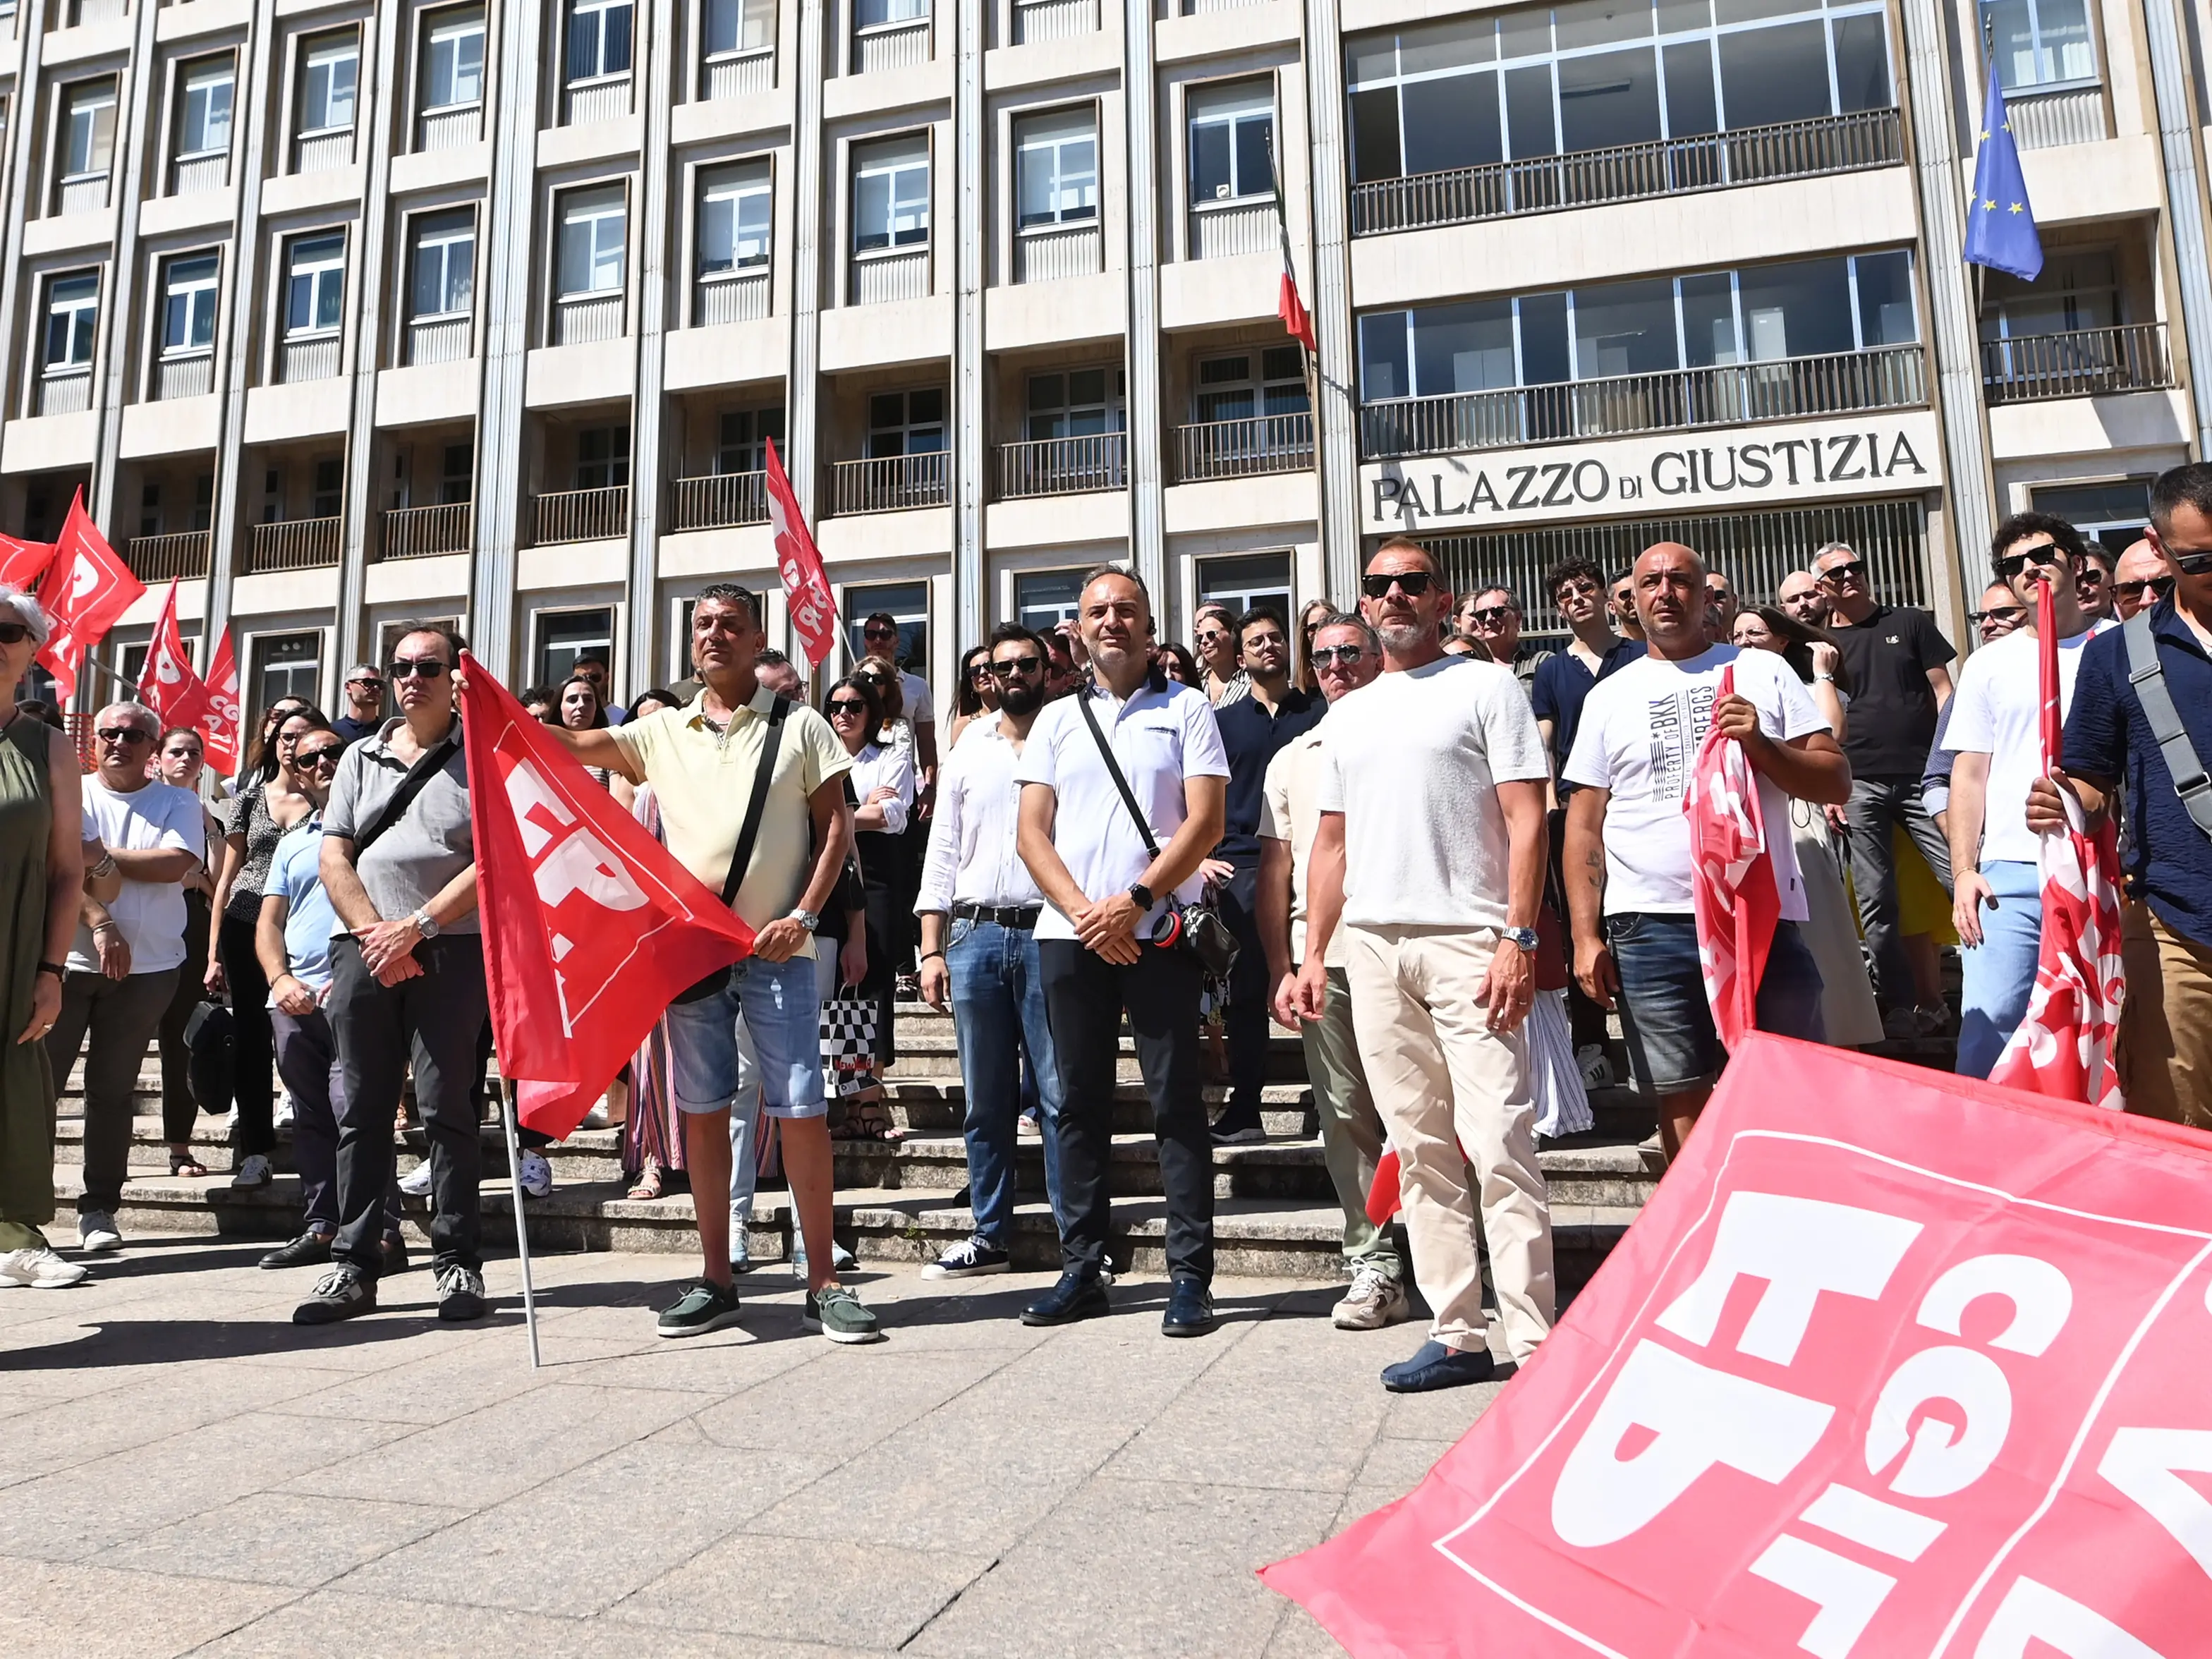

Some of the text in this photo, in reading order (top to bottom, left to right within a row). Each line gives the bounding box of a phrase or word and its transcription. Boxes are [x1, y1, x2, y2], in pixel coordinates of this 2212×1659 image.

[1371, 431, 1927, 521] PALAZZO DI GIUSTIZIA
[1664, 729, 1679, 741] OF
[1665, 746, 1682, 799] PROPERTY
